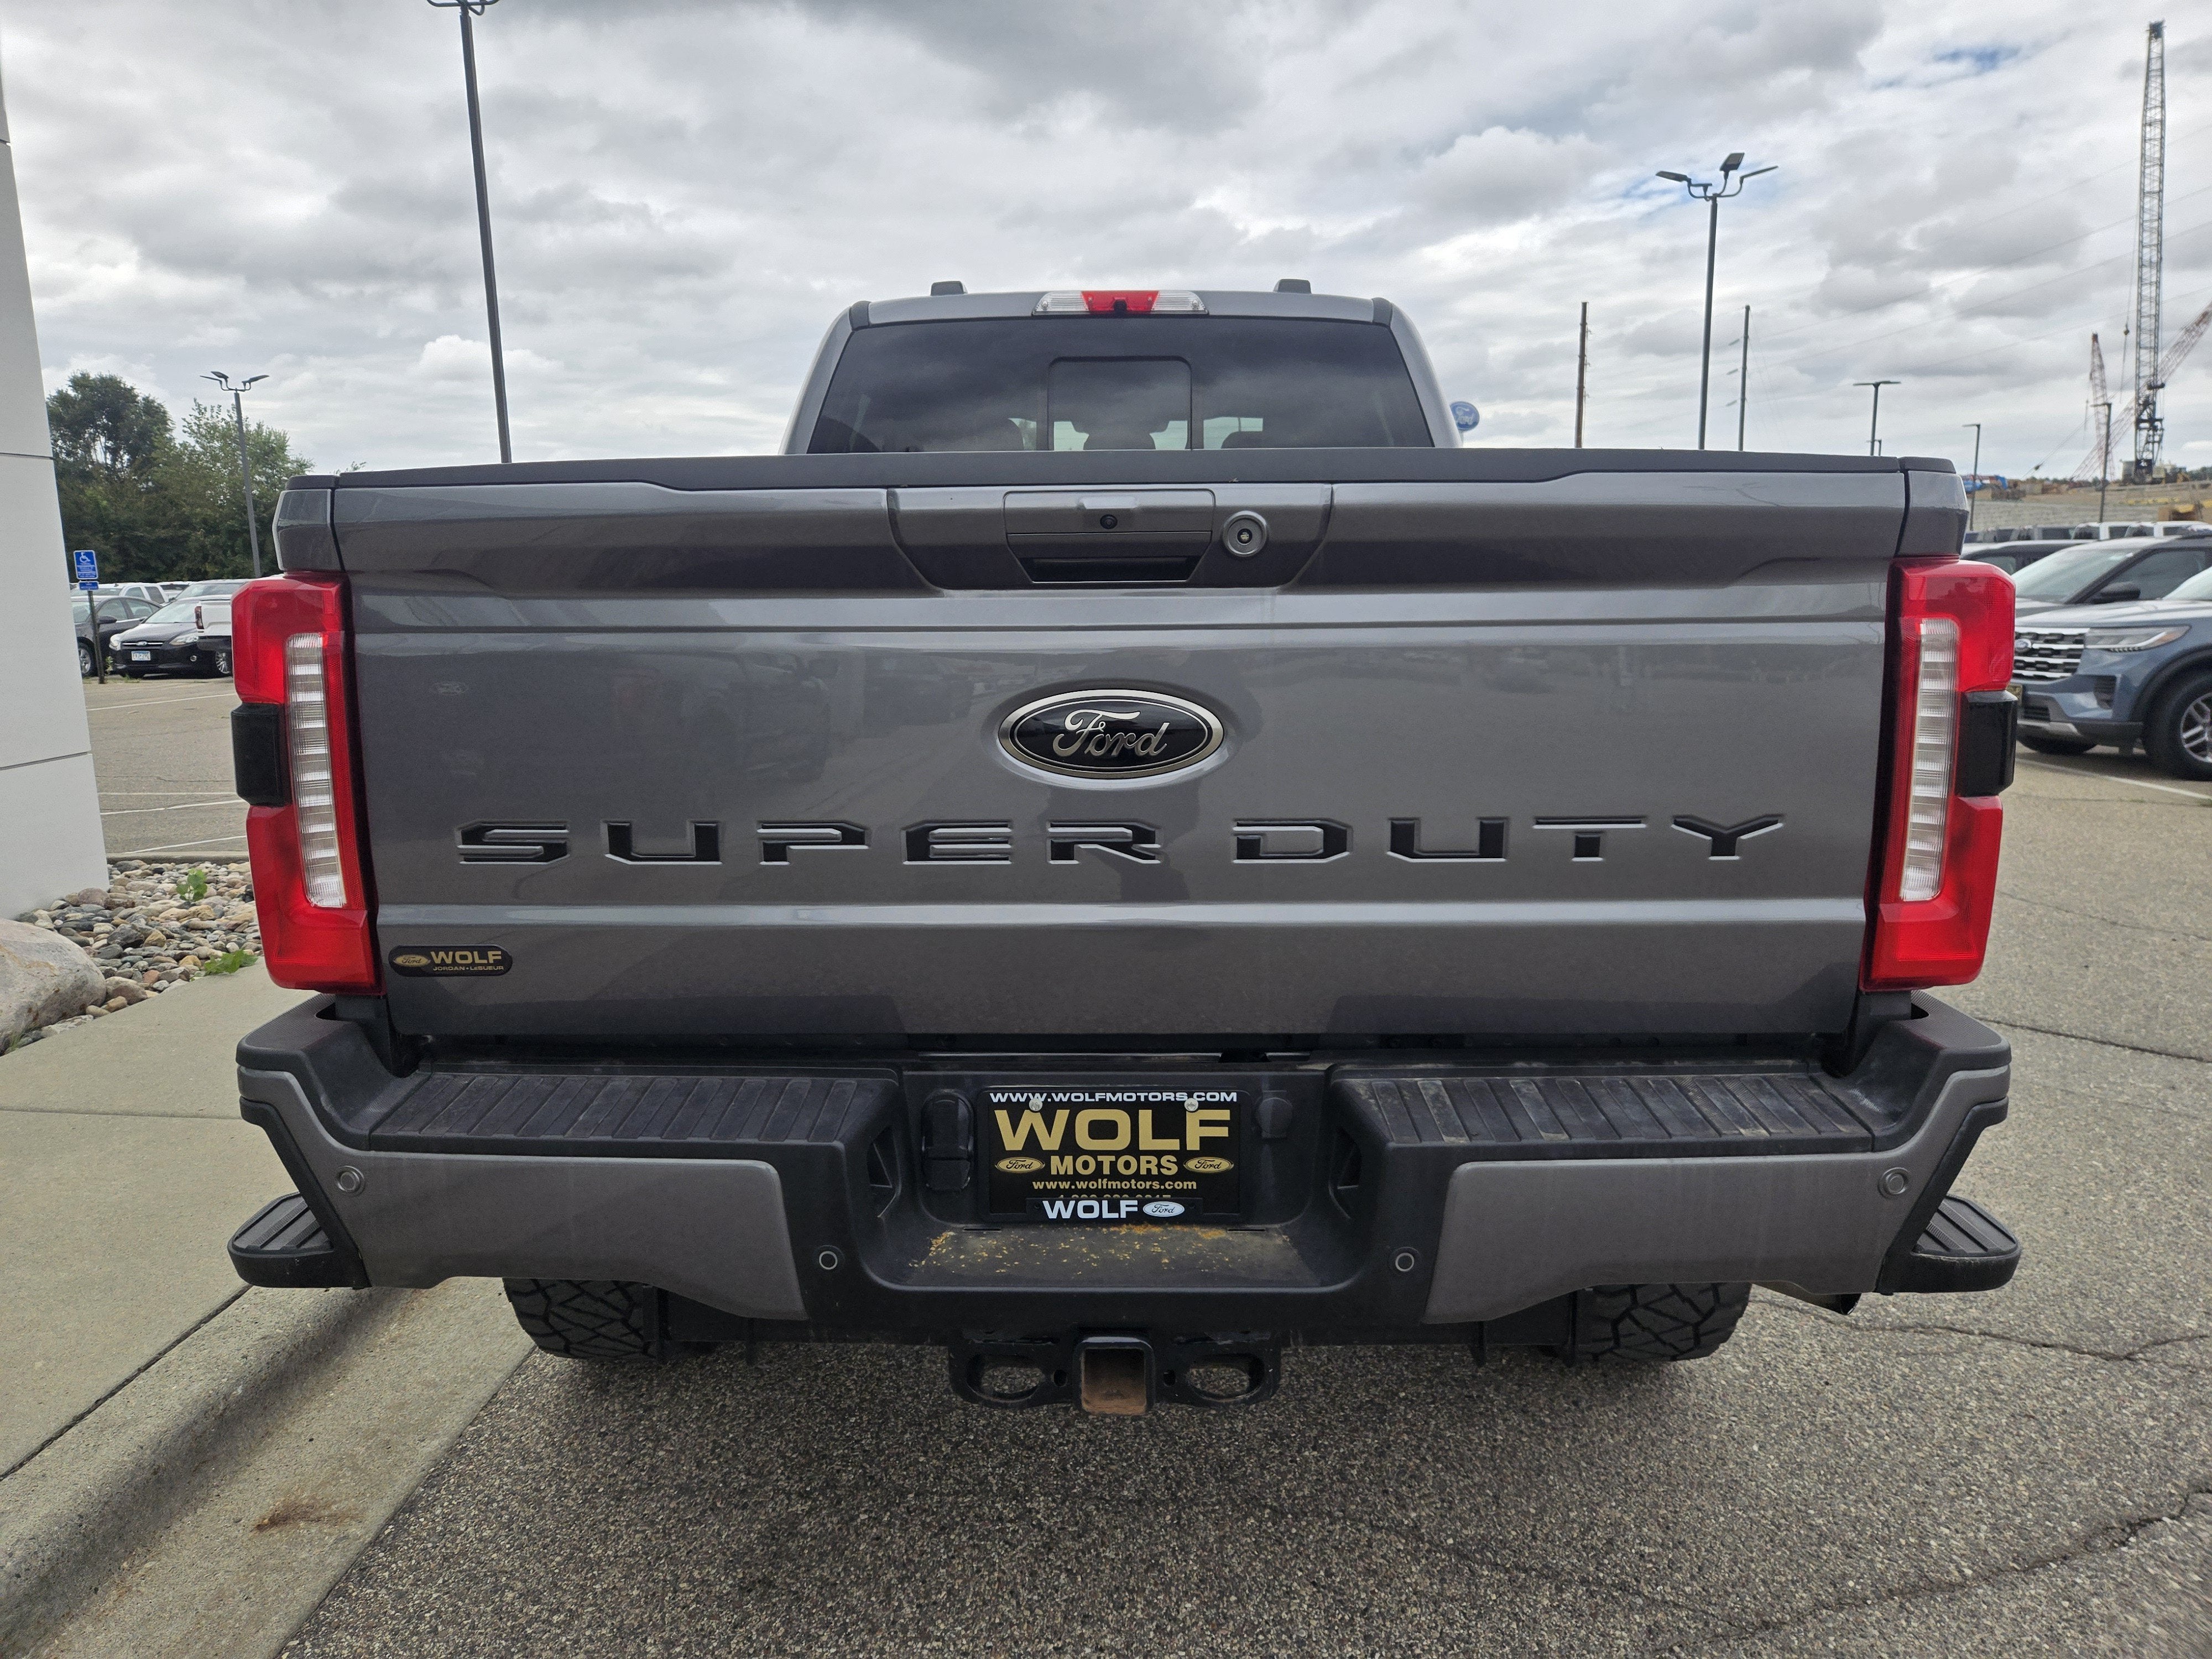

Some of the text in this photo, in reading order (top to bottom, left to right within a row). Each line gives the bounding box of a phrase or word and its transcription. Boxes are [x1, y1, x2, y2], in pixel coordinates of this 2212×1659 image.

[1053, 709, 1170, 757] Ford
[457, 816, 1783, 865] SUPER DUTY
[430, 951, 502, 963] WOLF
[989, 1092, 1237, 1103] WWW.WOLFMOTORSCOM
[994, 1109, 1230, 1151] WOLF
[1051, 1155, 1178, 1175] MOTORS
[1032, 1178, 1197, 1190] www.wolfmotors.com
[1042, 1200, 1138, 1219] WOLF
